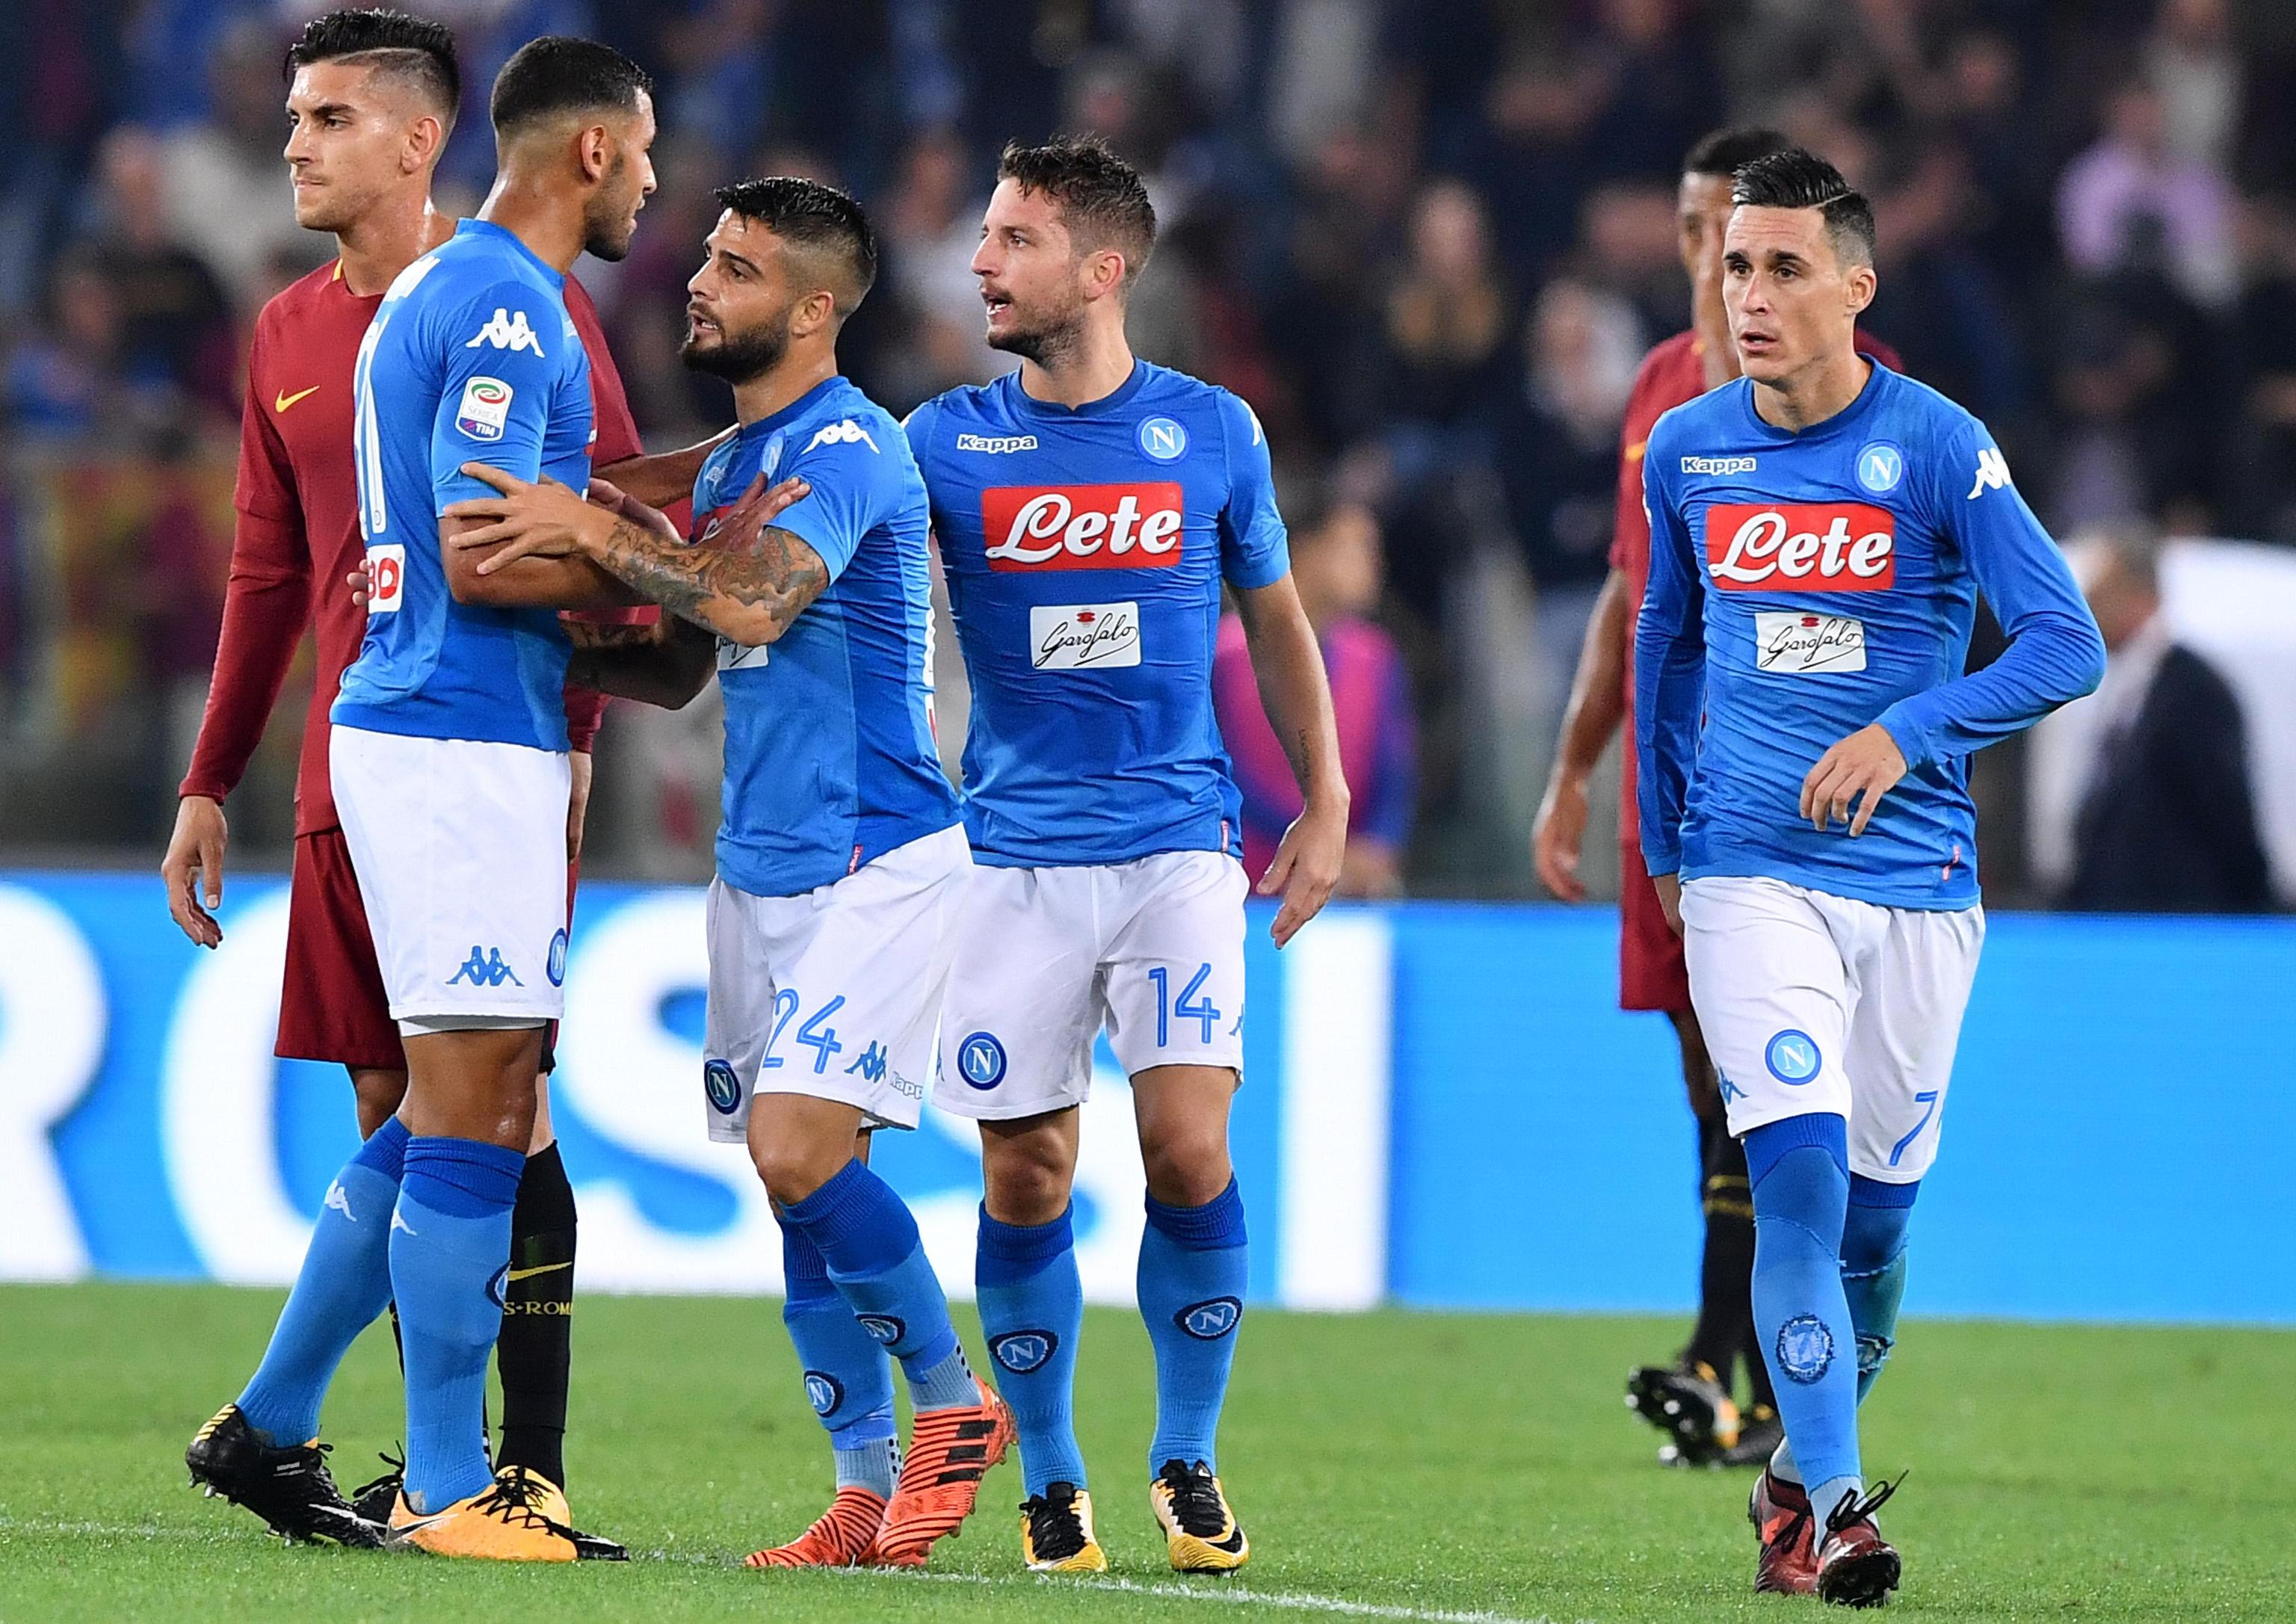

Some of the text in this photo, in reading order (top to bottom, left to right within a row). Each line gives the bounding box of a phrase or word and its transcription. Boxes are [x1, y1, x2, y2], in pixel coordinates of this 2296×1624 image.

[475, 422, 496, 437] TIM
[957, 433, 1038, 454] Kappa
[1149, 426, 1176, 451] N
[1681, 457, 1756, 475] Kappa
[1868, 454, 1892, 483] N
[985, 493, 1182, 564] Lete
[1709, 512, 1892, 583] Lete
[1034, 612, 1139, 667] Garofalo
[1759, 618, 1862, 671] Garofalo
[1148, 962, 1221, 1048] 14
[762, 987, 846, 1075] 24
[970, 1046, 993, 1076] N
[1780, 1043, 1807, 1071] N
[712, 1071, 732, 1102] N
[1888, 1090, 1939, 1167] 7
[1200, 1309, 1226, 1330] N
[1008, 1342, 1034, 1363] N
[809, 1381, 827, 1406] N
